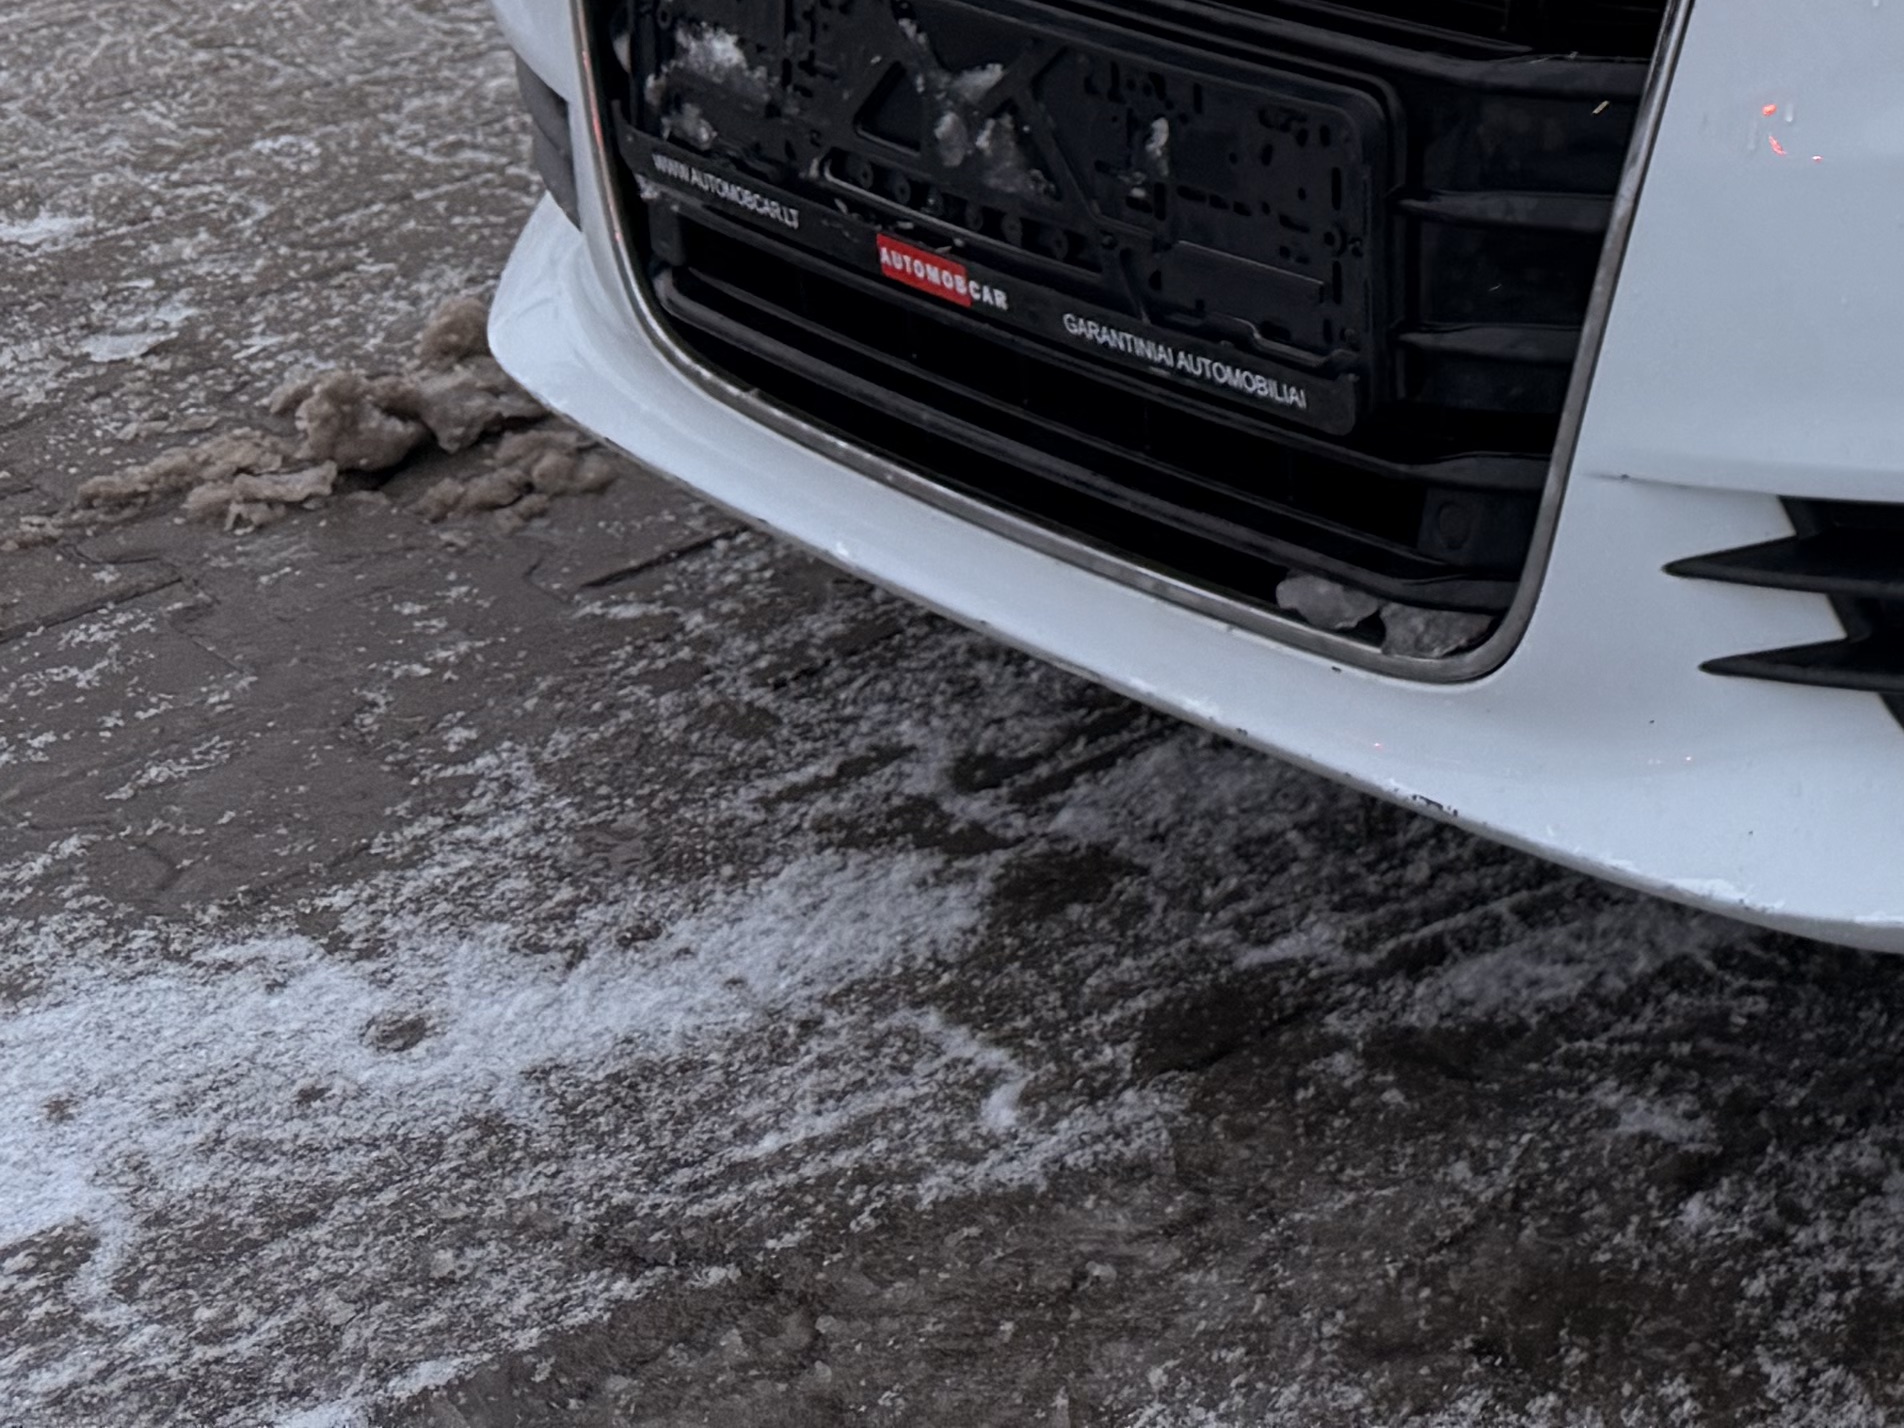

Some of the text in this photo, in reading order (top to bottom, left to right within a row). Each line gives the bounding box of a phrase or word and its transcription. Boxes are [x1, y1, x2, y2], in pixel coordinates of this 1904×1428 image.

[880, 246, 1008, 311] AUTOMOBCAR
[1062, 313, 1307, 408] GARANTINIAI AUTOMOBILIAI
